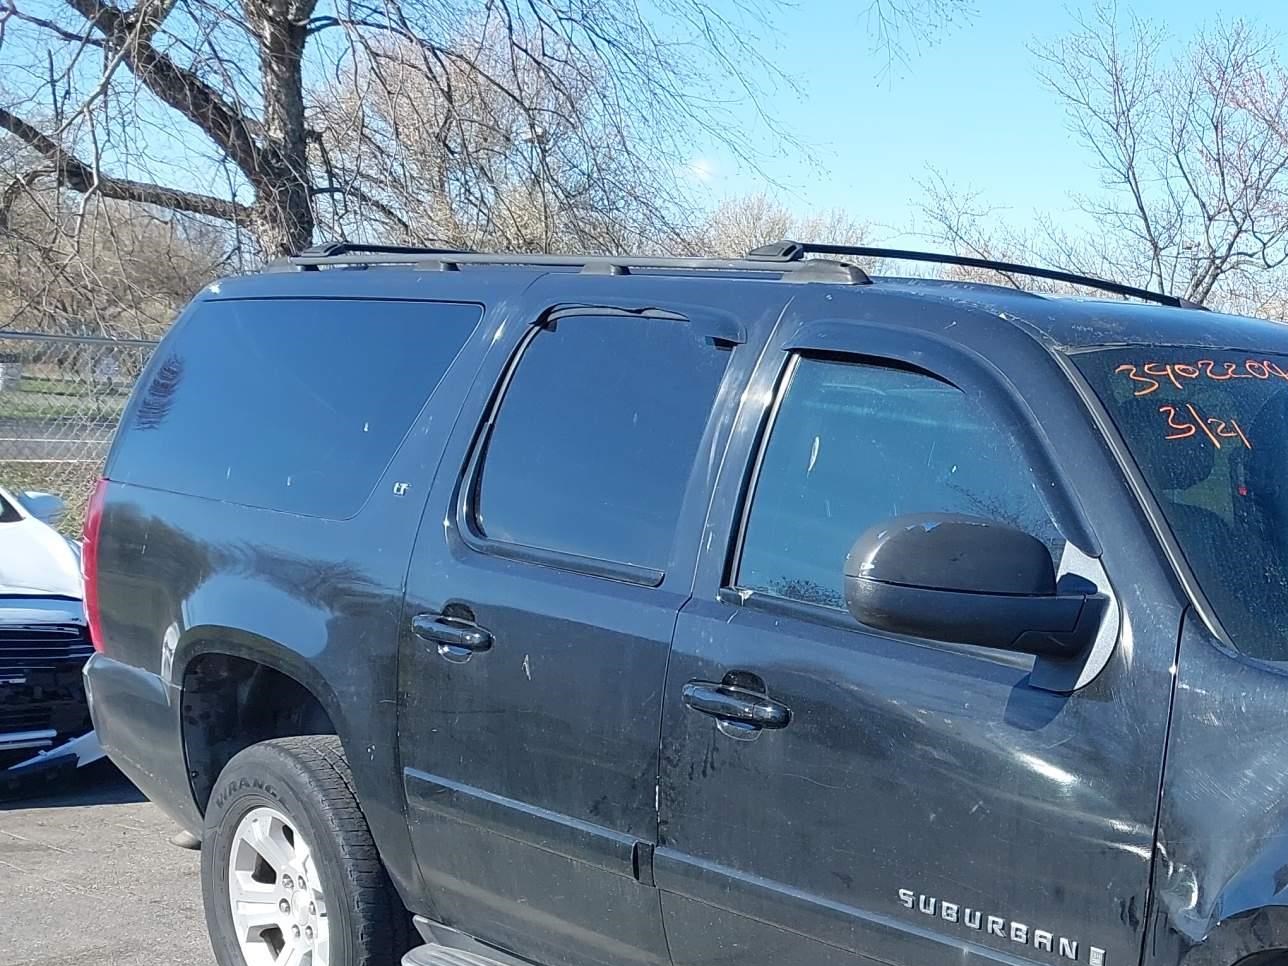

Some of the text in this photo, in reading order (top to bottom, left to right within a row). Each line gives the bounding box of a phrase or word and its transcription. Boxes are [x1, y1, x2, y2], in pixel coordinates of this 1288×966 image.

[1159, 403, 1252, 449] 3/21
[393, 481, 412, 496] LT
[898, 888, 1079, 960] SUBURBAN
